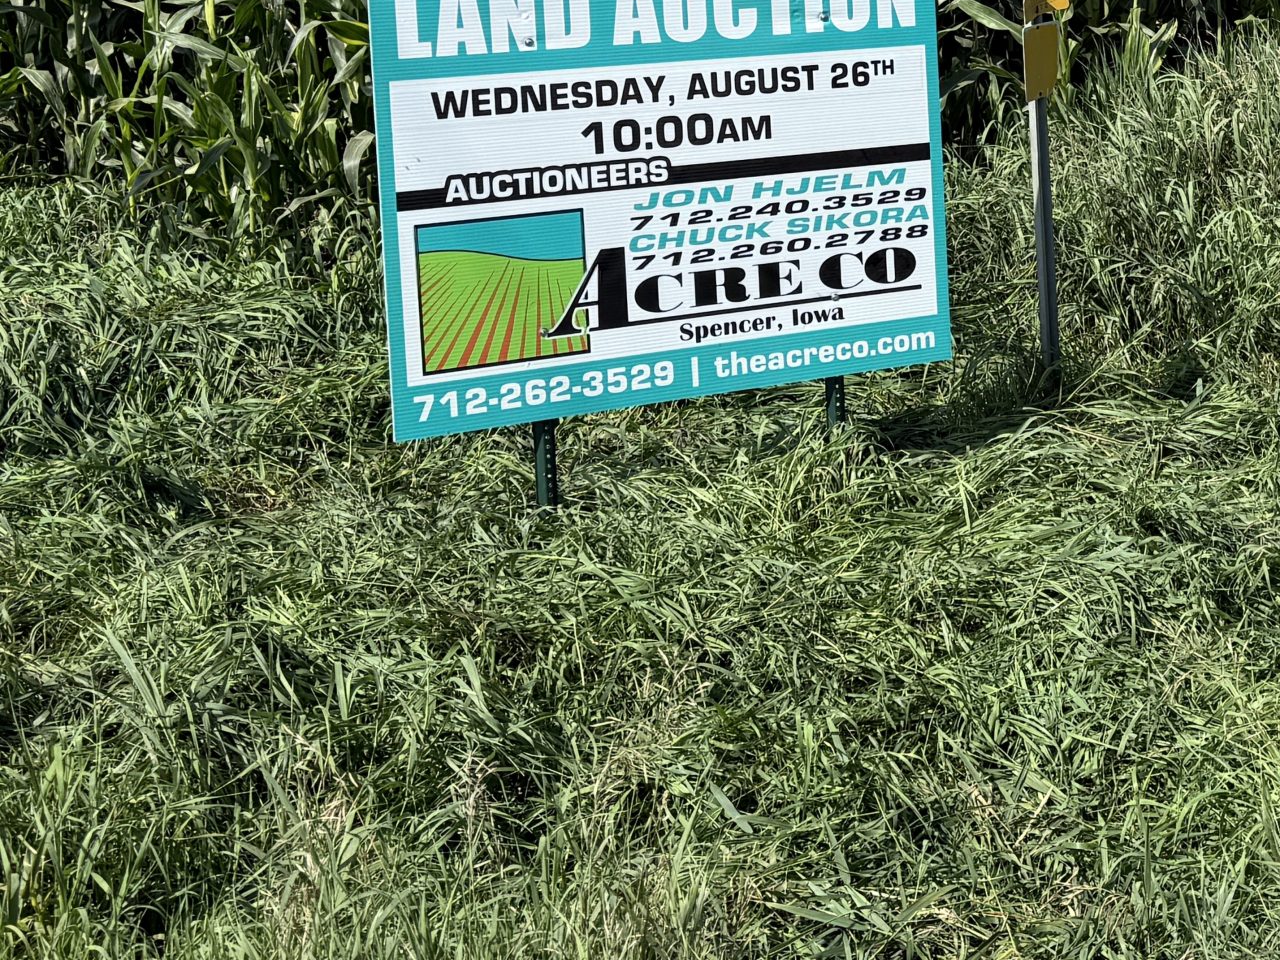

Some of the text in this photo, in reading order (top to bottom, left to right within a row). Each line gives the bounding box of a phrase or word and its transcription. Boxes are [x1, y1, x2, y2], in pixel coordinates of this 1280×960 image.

[431, 75, 676, 120] WEDNESDAY,
[687, 65, 819, 100] AUGUST
[581, 113, 772, 154] 10:00AM
[445, 160, 669, 203] AUCTIONEERS
[633, 168, 907, 212] JON HJELM
[628, 205, 930, 253] CHUCK SIKORA
[630, 187, 927, 231] 712.240.3529
[631, 224, 929, 271] 712.260.2788
[548, 246, 916, 338] ACRE CO
[679, 305, 845, 342] Spencer, Iowa
[413, 360, 675, 422] 712-262-3529
[714, 331, 936, 379] theacreco.com
